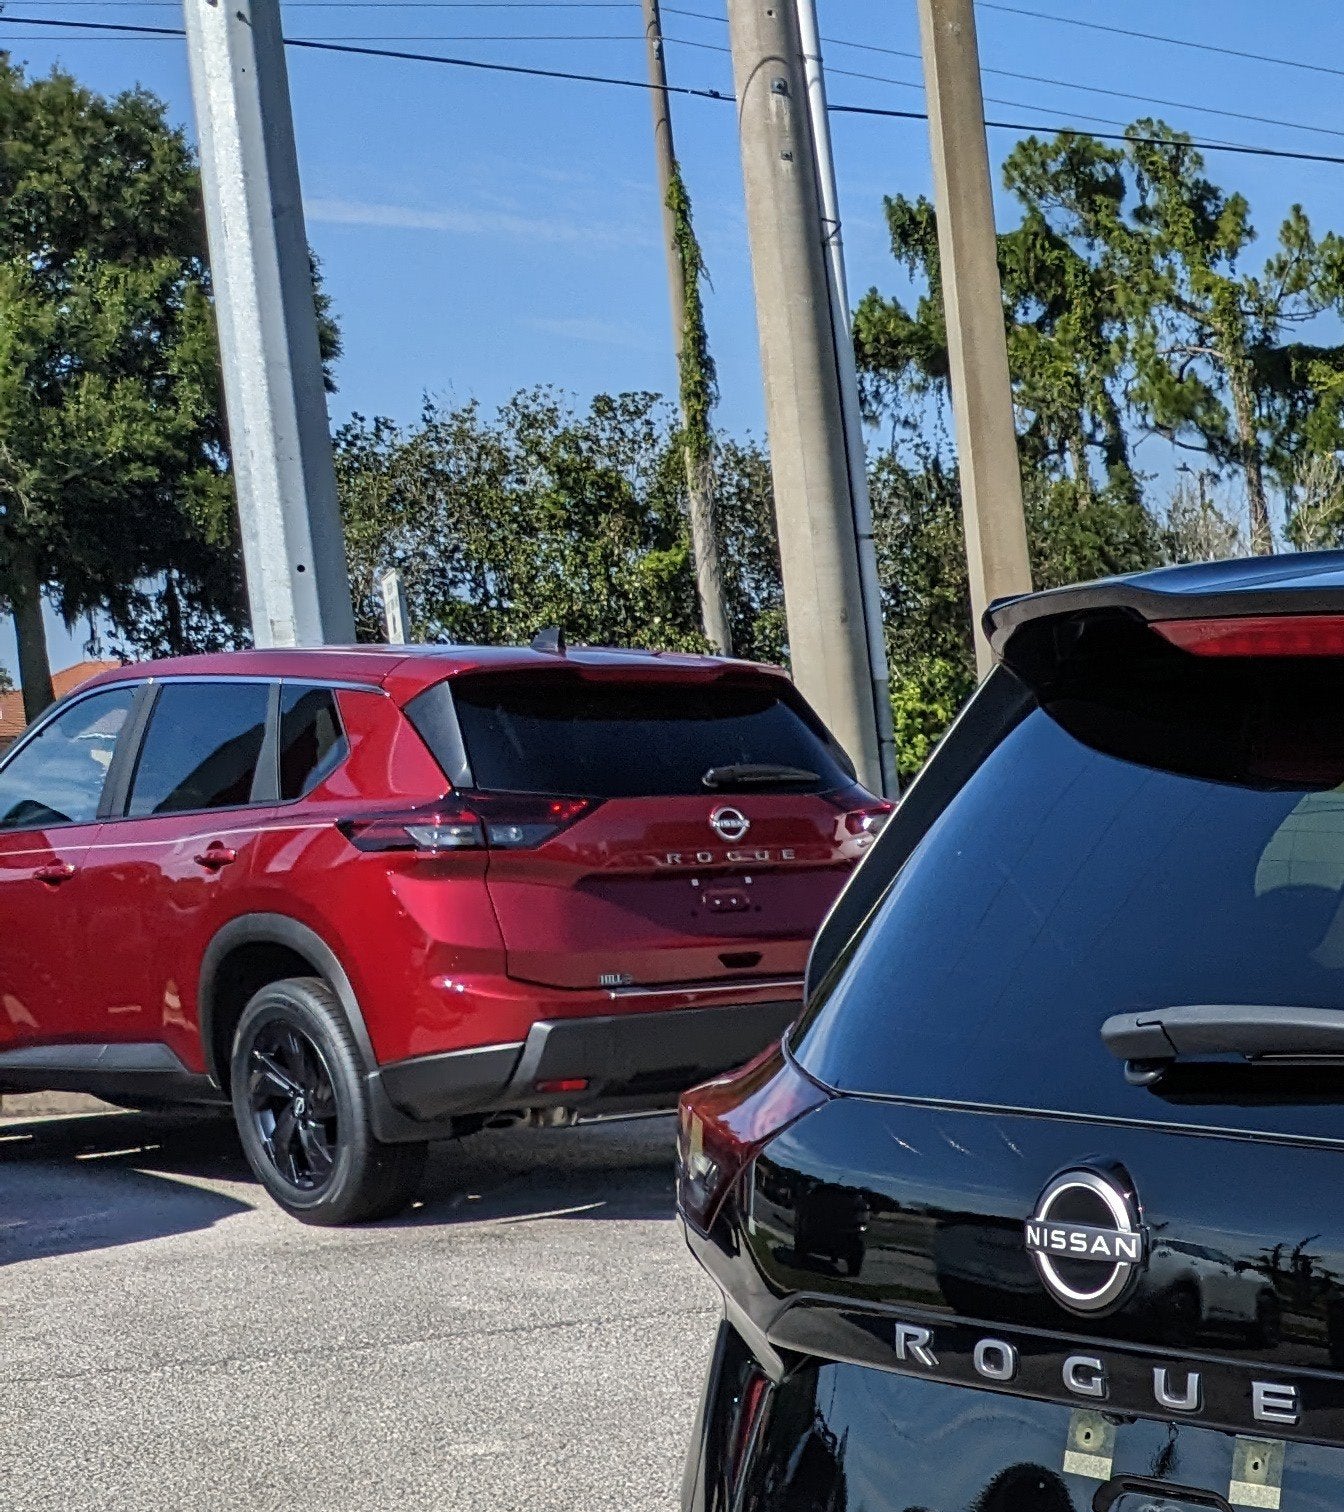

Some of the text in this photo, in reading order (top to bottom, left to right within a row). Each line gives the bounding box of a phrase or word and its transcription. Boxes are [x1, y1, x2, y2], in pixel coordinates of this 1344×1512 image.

[667, 850, 795, 864] ROGUE
[1027, 1225, 1137, 1258] NISSAN
[895, 1322, 1298, 1424] ROGUE
